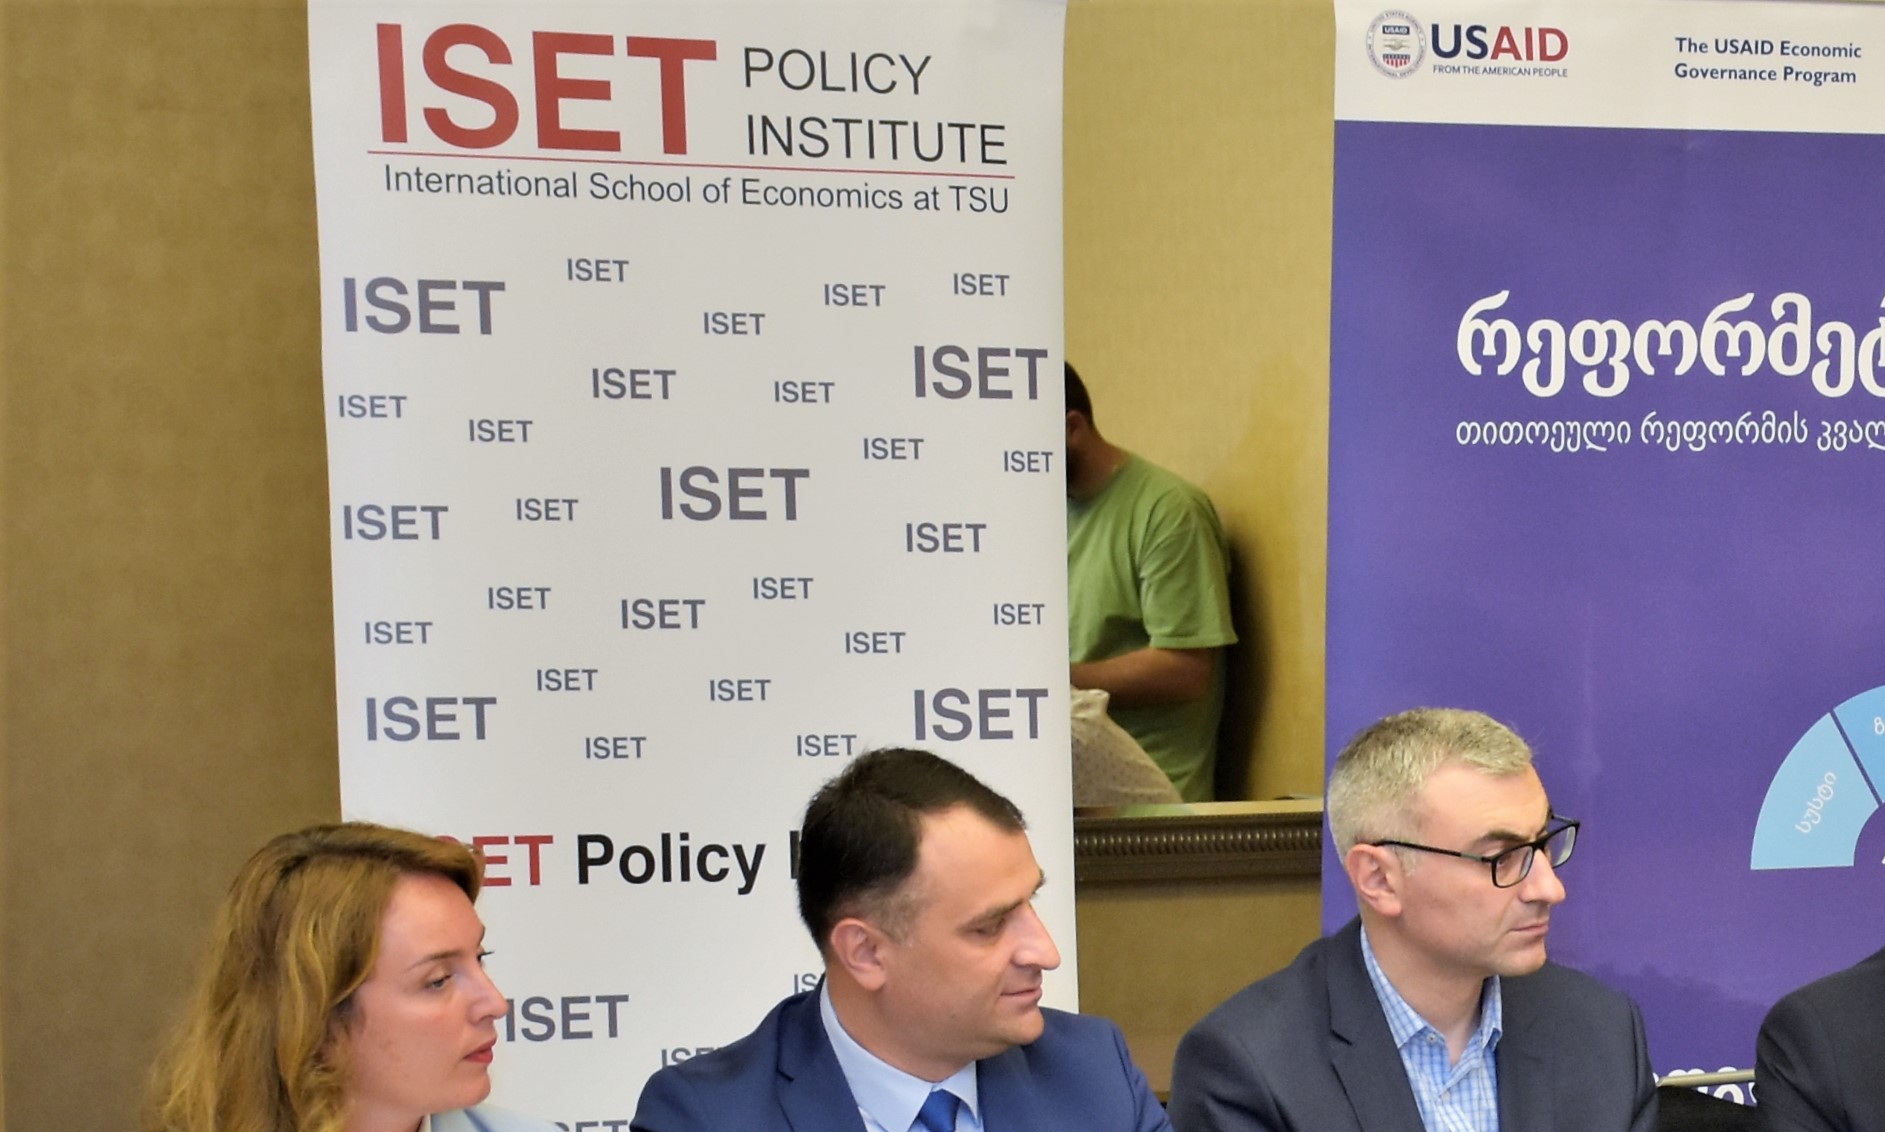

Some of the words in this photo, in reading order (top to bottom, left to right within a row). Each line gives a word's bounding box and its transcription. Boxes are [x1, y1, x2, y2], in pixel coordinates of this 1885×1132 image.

[1431, 23, 1569, 62] USAID
[1675, 37, 1709, 54] The
[1714, 39, 1774, 57] USAID
[1779, 40, 1862, 60] Economic
[743, 46, 932, 97] POLICY
[1433, 65, 1460, 74] FROM
[1462, 65, 1480, 75] THE
[1482, 66, 1531, 77] AMERICAN
[1532, 67, 1568, 78] PEOPLE
[1674, 63, 1779, 83] Governance
[1784, 66, 1857, 86] Program
[376, 22, 717, 156] ISET
[746, 114, 1008, 165] INSTITUTE
[384, 164, 578, 199] International
[588, 172, 691, 204] School
[702, 175, 730, 205] of
[741, 178, 903, 209] Economics
[912, 184, 941, 212] at
[948, 186, 1010, 214] TSU
[568, 258, 629, 282] ISET
[824, 284, 886, 307] ISET
[954, 273, 1010, 296] ISET
[344, 277, 505, 335] ISET
[704, 312, 765, 335] ISET
[592, 368, 676, 399] ISET
[914, 345, 1048, 400] ISET
[775, 381, 835, 403] ISET
[339, 395, 407, 418] ISET
[469, 419, 533, 442] ISET
[864, 438, 924, 460] ISET
[1004, 450, 1053, 472] ISET
[660, 466, 810, 521] ISET
[517, 498, 579, 521] ISET
[344, 504, 448, 540] ISET
[906, 523, 986, 553] ISET
[488, 587, 551, 610] ISET
[753, 577, 814, 599] ISET
[622, 599, 705, 630] ISET
[994, 603, 1045, 625] ISET
[365, 621, 433, 644] ISET
[846, 632, 906, 654] ISET
[537, 669, 598, 691] ISET
[710, 679, 771, 701] ISET
[366, 696, 497, 741] ISET
[914, 688, 1048, 741] ISET
[586, 737, 646, 759] ISET
[797, 734, 857, 756] ISET
[436, 834, 554, 887] ET
[577, 832, 766, 895] Policy
[506, 995, 629, 1042] ISET
